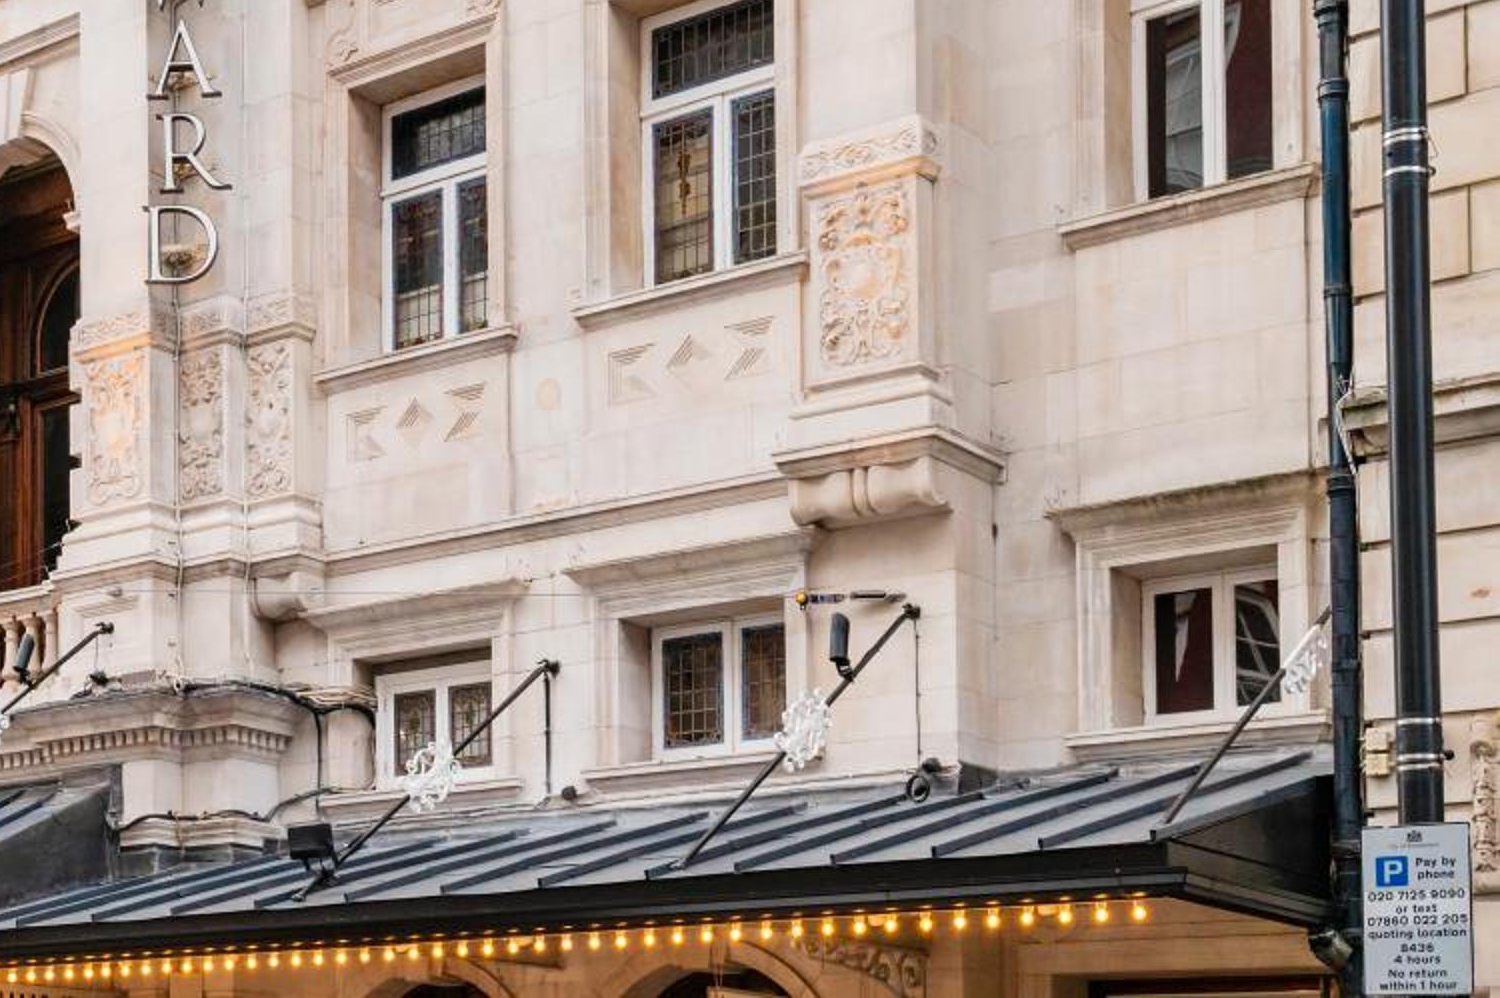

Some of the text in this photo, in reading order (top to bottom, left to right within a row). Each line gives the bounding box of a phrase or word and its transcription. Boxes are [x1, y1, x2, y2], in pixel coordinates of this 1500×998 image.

[1415, 855, 1457, 868] Pay by
[1417, 869, 1455, 880] phone
[1368, 888, 1465, 902] 020 7125 9090
[1396, 904, 1437, 914] or text
[1368, 928, 1467, 940] quoting location
[1393, 955, 1441, 964] 4 hours
[1388, 969, 1447, 978] No return
[1380, 981, 1417, 990] within
[1429, 981, 1457, 990] hour
